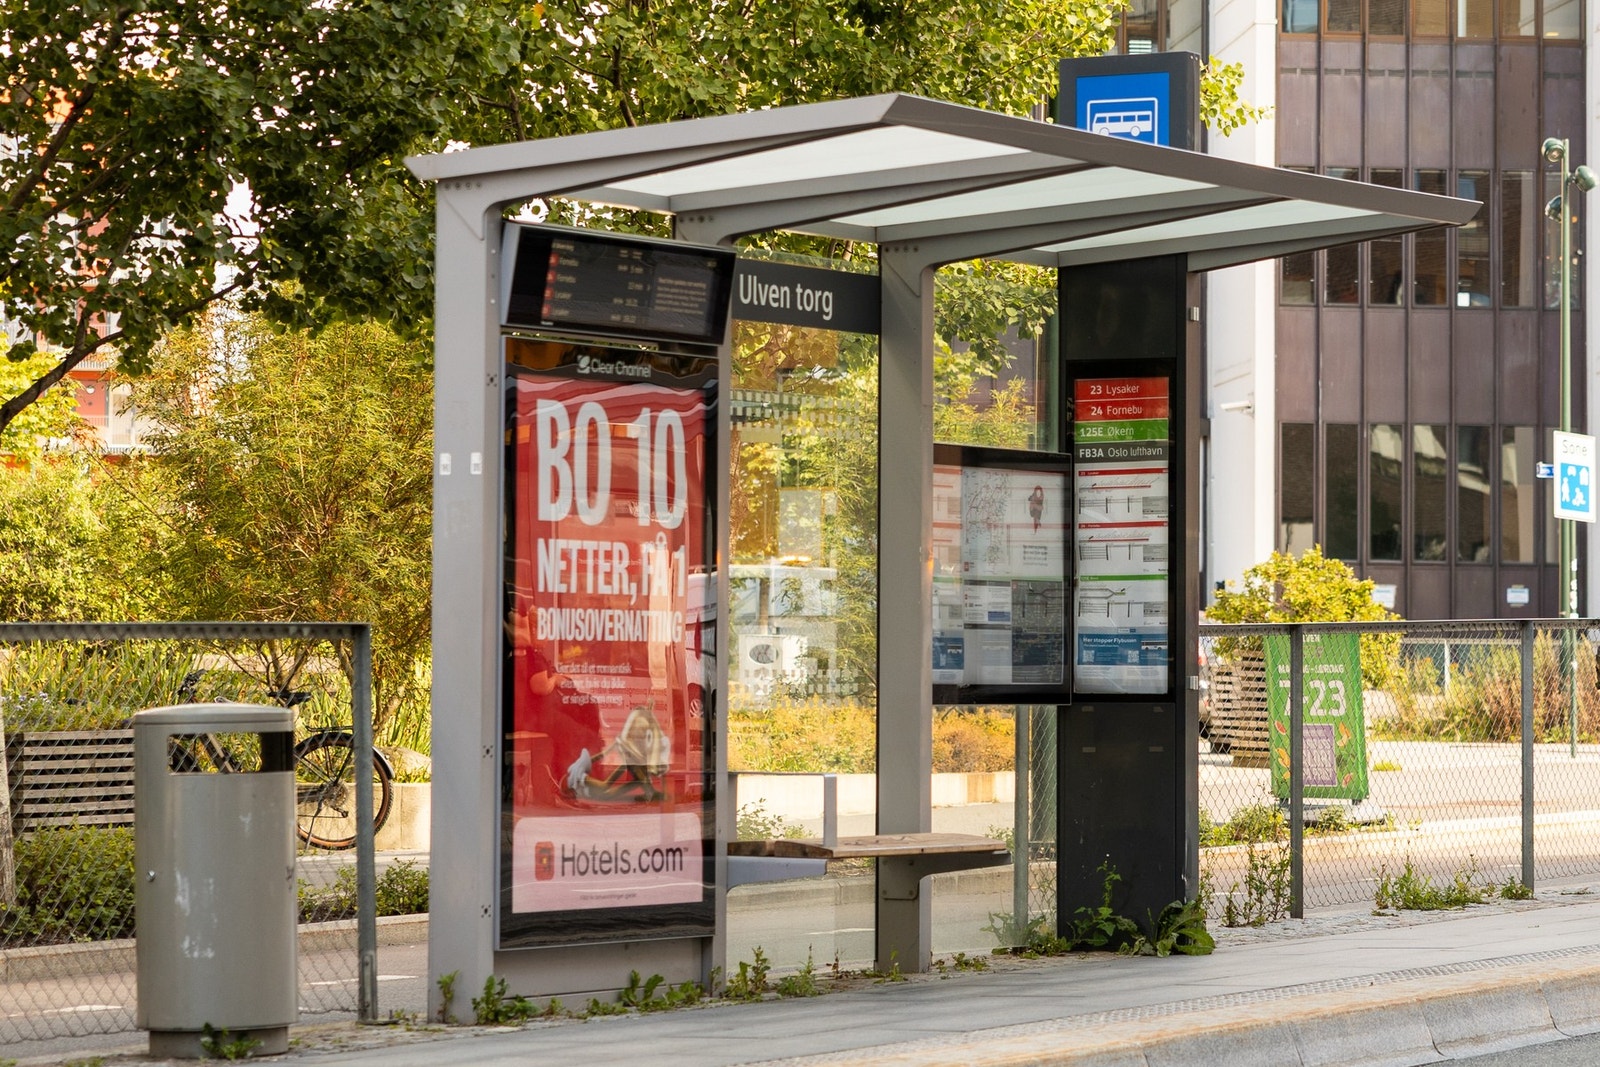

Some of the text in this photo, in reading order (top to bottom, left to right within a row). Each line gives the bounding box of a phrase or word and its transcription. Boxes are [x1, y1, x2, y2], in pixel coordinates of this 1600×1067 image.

[739, 273, 790, 309] Ulven
[796, 283, 833, 320] torg
[590, 358, 652, 378] Clear Channel
[1090, 384, 1139, 396] 23 Lysaker
[1091, 405, 1142, 416] 24 Fornebu
[1080, 426, 1134, 437] 125E Økern
[1079, 446, 1163, 458] FB3A Oslo lufthavn
[1562, 439, 1588, 456] Sone
[537, 399, 687, 530] BO 10
[537, 531, 686, 606] NETTER, FÅ 1
[537, 608, 683, 643] BONUSOVERNATTING
[561, 842, 683, 877] Hotels.com
